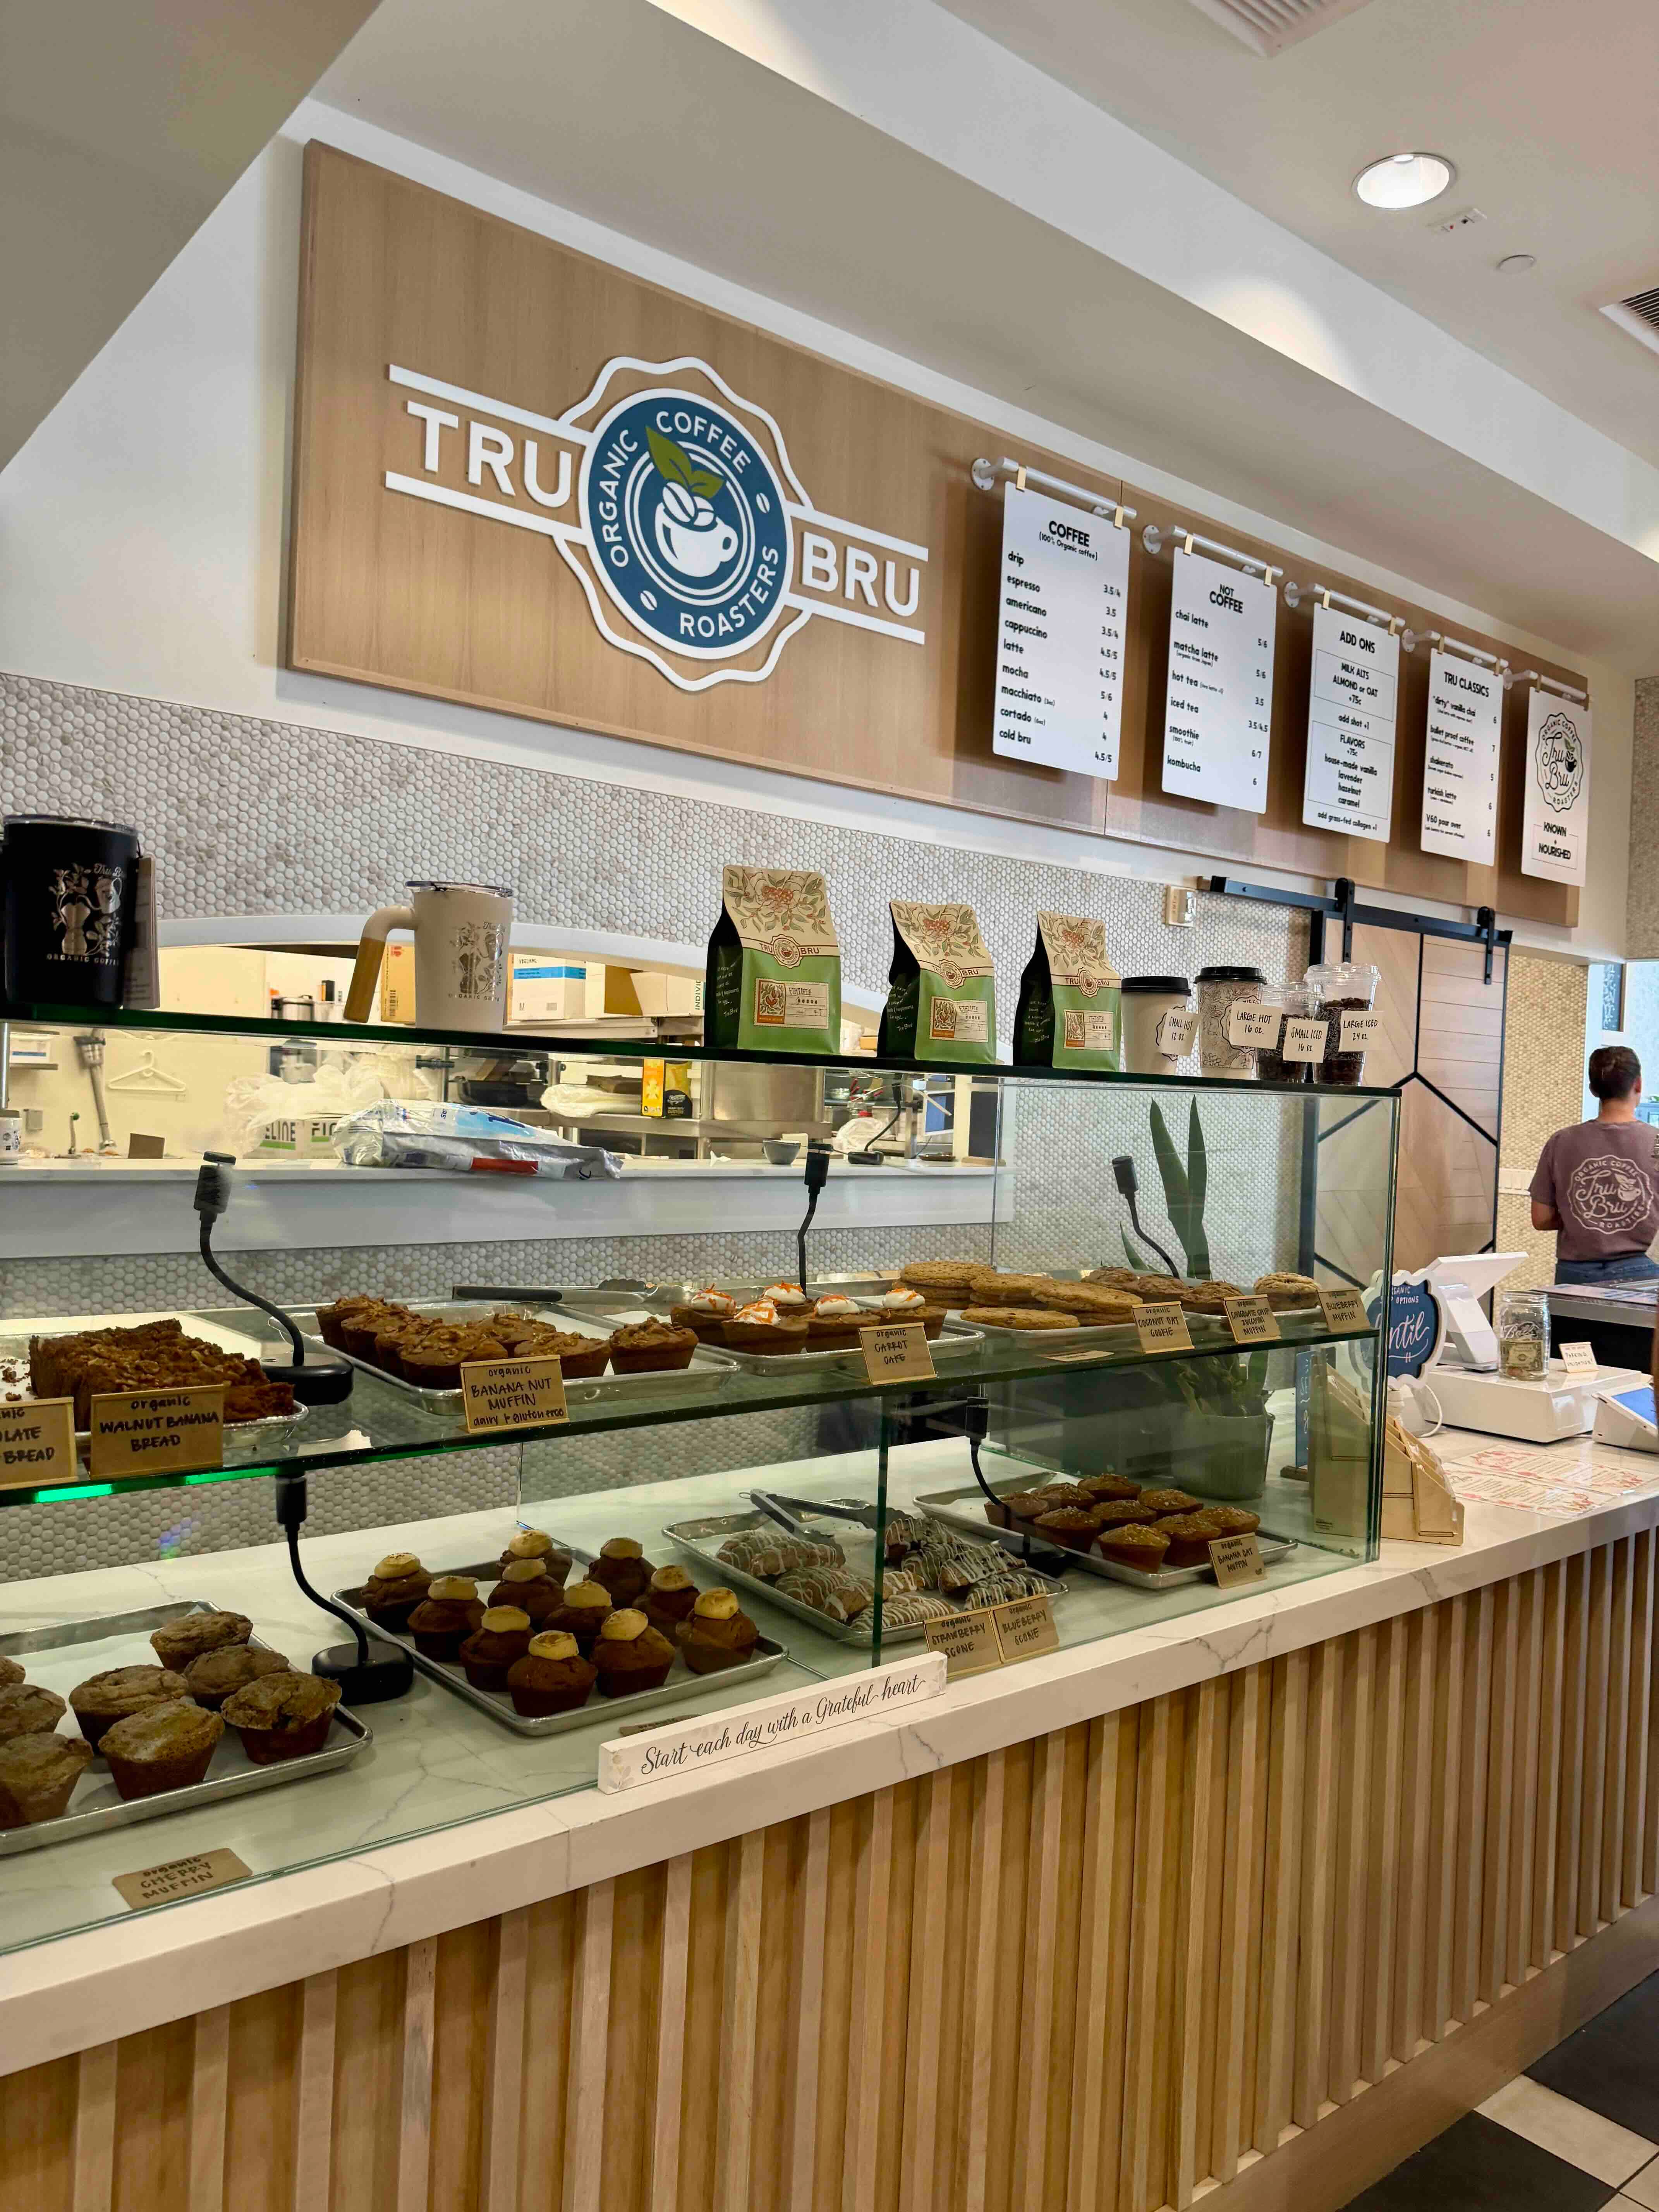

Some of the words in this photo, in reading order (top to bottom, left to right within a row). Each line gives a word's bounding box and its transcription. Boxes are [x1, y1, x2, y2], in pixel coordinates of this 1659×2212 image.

[656, 410, 752, 475] COFFEE
[603, 428, 639, 568] ORGANIC
[406, 400, 573, 509] TRU
[801, 531, 920, 617] BRU
[1049, 520, 1090, 547] COFFEE
[1057, 539, 1077, 553] Organic
[1079, 550, 1097, 561] coffee)
[1008, 551, 1024, 567] drip
[1103, 584, 1120, 597] 3.5/4
[679, 544, 779, 639] ROASTERS
[1007, 575, 1040, 592] espresso
[1106, 606, 1116, 617] 3.5
[1220, 584, 1234, 597] NOT
[1209, 591, 1243, 614] COFFEE
[1006, 598, 1047, 617] americano
[1101, 626, 1118, 639] 3.5/4
[1175, 610, 1189, 621] chai
[1192, 614, 1209, 628] latte
[1258, 638, 1267, 648] 5/6
[1005, 620, 1048, 639] cappuccino
[1101, 647, 1118, 659] 4.5/5
[1340, 630, 1356, 646] ADD
[1359, 638, 1375, 653] ONS
[1003, 638, 1024, 654] latte
[1099, 668, 1116, 680] 4.5/5
[1174, 641, 1199, 656] matcha
[1202, 647, 1218, 661] latte
[1256, 670, 1266, 678] 5/6
[1341, 663, 1355, 675] MILK
[1356, 668, 1369, 680] ALTS
[1002, 665, 1029, 678] mocha
[1101, 691, 1112, 701] 5/6
[1172, 670, 1183, 682] hot
[1187, 676, 1198, 687] tea
[1255, 697, 1264, 706] 3.5
[1333, 675, 1357, 690] ALMOND
[1367, 687, 1378, 697] OAT
[1444, 672, 1458, 685] TRU
[1459, 678, 1489, 697] CLASSICS
[1001, 686, 1041, 702] macchiato
[1103, 711, 1108, 720] 4
[1171, 697, 1184, 709] iced
[1187, 702, 1199, 713] tea
[1249, 720, 1268, 732] 3.5/4.5
[1339, 714, 1349, 723] add
[1351, 718, 1362, 727] shot
[1000, 708, 1031, 722] cortado
[1102, 732, 1106, 740] 4
[1000, 729, 1015, 740] cold
[1018, 732, 1031, 744] bru
[1095, 752, 1112, 763] 4.5/5
[1169, 725, 1199, 740] smoothie
[1252, 750, 1261, 758] 6/7
[1340, 734, 1365, 749] FLAVORS
[1460, 736, 1474, 745] coffee
[1542, 732, 1565, 766] Tru
[1167, 755, 1200, 772] kombucha
[1324, 753, 1358, 771] house-made
[1360, 766, 1377, 776] vanilla
[1338, 770, 1362, 784] lavender
[1545, 761, 1569, 790] Bru
[1338, 782, 1361, 795] hazelnut
[1338, 797, 1360, 808] caramel
[1353, 820, 1371, 830] collagen
[1426, 814, 1437, 823] V60
[1544, 822, 1567, 836] KNOWN
[1539, 843, 1571, 860] NOURISHED
[759, 943, 773, 953] TRU
[1169, 1016, 1182, 1028] SMALL
[1184, 1021, 1193, 1032] HOT
[1237, 1013, 1255, 1022] LARGE
[1259, 1015, 1272, 1024] HOT
[1343, 1020, 1364, 1029] LARGE
[1171, 1032, 1176, 1041] 12
[1245, 1024, 1252, 1033] 16
[1291, 1027, 1309, 1039] SMALL
[1311, 1030, 1322, 1040] ICED
[1353, 1033, 1360, 1041] 24
[1298, 1043, 1304, 1051] 16
[1575, 1161, 1607, 1181] ORGANIC
[1576, 1170, 1617, 1201] Tru
[1583, 1194, 1628, 1218] Bru
[1326, 1298, 1358, 1310] BLUEBERRY
[1396, 1296, 1419, 1304] OPTIONS
[1138, 1317, 1164, 1328] COCONUT
[1167, 1317, 1179, 1325] OAT
[1333, 1310, 1356, 1321] MUFFIN
[876, 1329, 907, 1338] organic
[1151, 1327, 1173, 1337] COOKIE
[1243, 1325, 1266, 1335] MUFFIN
[875, 1340, 908, 1352] CARROT
[884, 1353, 905, 1365] CAKE
[488, 1366, 531, 1377] organic
[471, 1382, 524, 1398] BANANA
[528, 1377, 551, 1390] NUT
[130, 1396, 191, 1413] organic
[488, 1394, 536, 1410] MUFFIN
[100, 1416, 163, 1434] WALNUT
[167, 1412, 219, 1429] BANANA
[474, 1416, 498, 1425] dairy
[131, 1434, 180, 1452] BREAD
[3, 1447, 55, 1464] BREAD
[1218, 1551, 1241, 1565] BANANA
[1243, 1548, 1253, 1558] OAT
[1227, 1559, 1248, 1572] MUFFIN
[1009, 1603, 1032, 1615] organic
[941, 1616, 971, 1628] organic
[1003, 1610, 1046, 1633] BLUEBERRY
[932, 1623, 986, 1645] STRAWBERRY
[1015, 1628, 1039, 1646] SCONE
[945, 1642, 975, 1659] SCONE
[641, 1742, 689, 1775] Start
[689, 1727, 732, 1757] each
[736, 1720, 778, 1748] day
[767, 1708, 799, 1736] with
[802, 1711, 812, 1724] a
[816, 1684, 879, 1725] Grateful
[879, 1674, 926, 1700] heart
[141, 1862, 211, 1889] CHERRY
[143, 1857, 202, 1877] organic
[142, 1872, 214, 1899] MUFFIN
